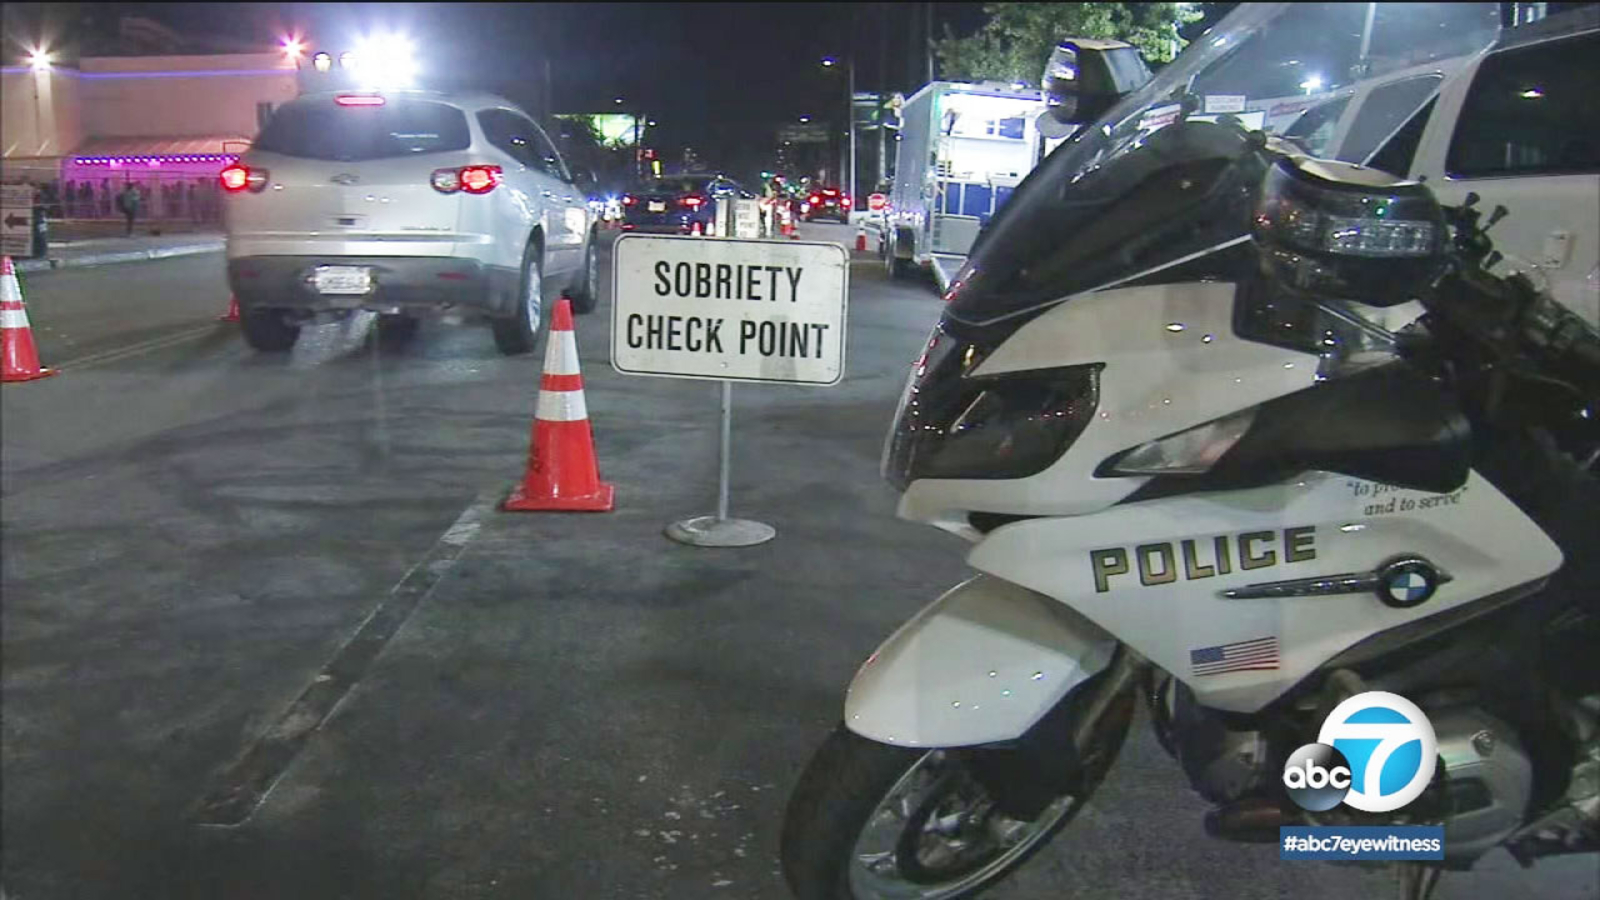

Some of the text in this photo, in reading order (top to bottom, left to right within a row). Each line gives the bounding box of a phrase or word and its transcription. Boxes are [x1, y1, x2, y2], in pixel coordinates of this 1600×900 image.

[654, 260, 803, 303] SOBRIETY
[627, 313, 830, 359] CHECK POINT
[1364, 498, 1396, 516] and
[1400, 498, 1416, 511] to
[1090, 525, 1317, 593] POLICE
